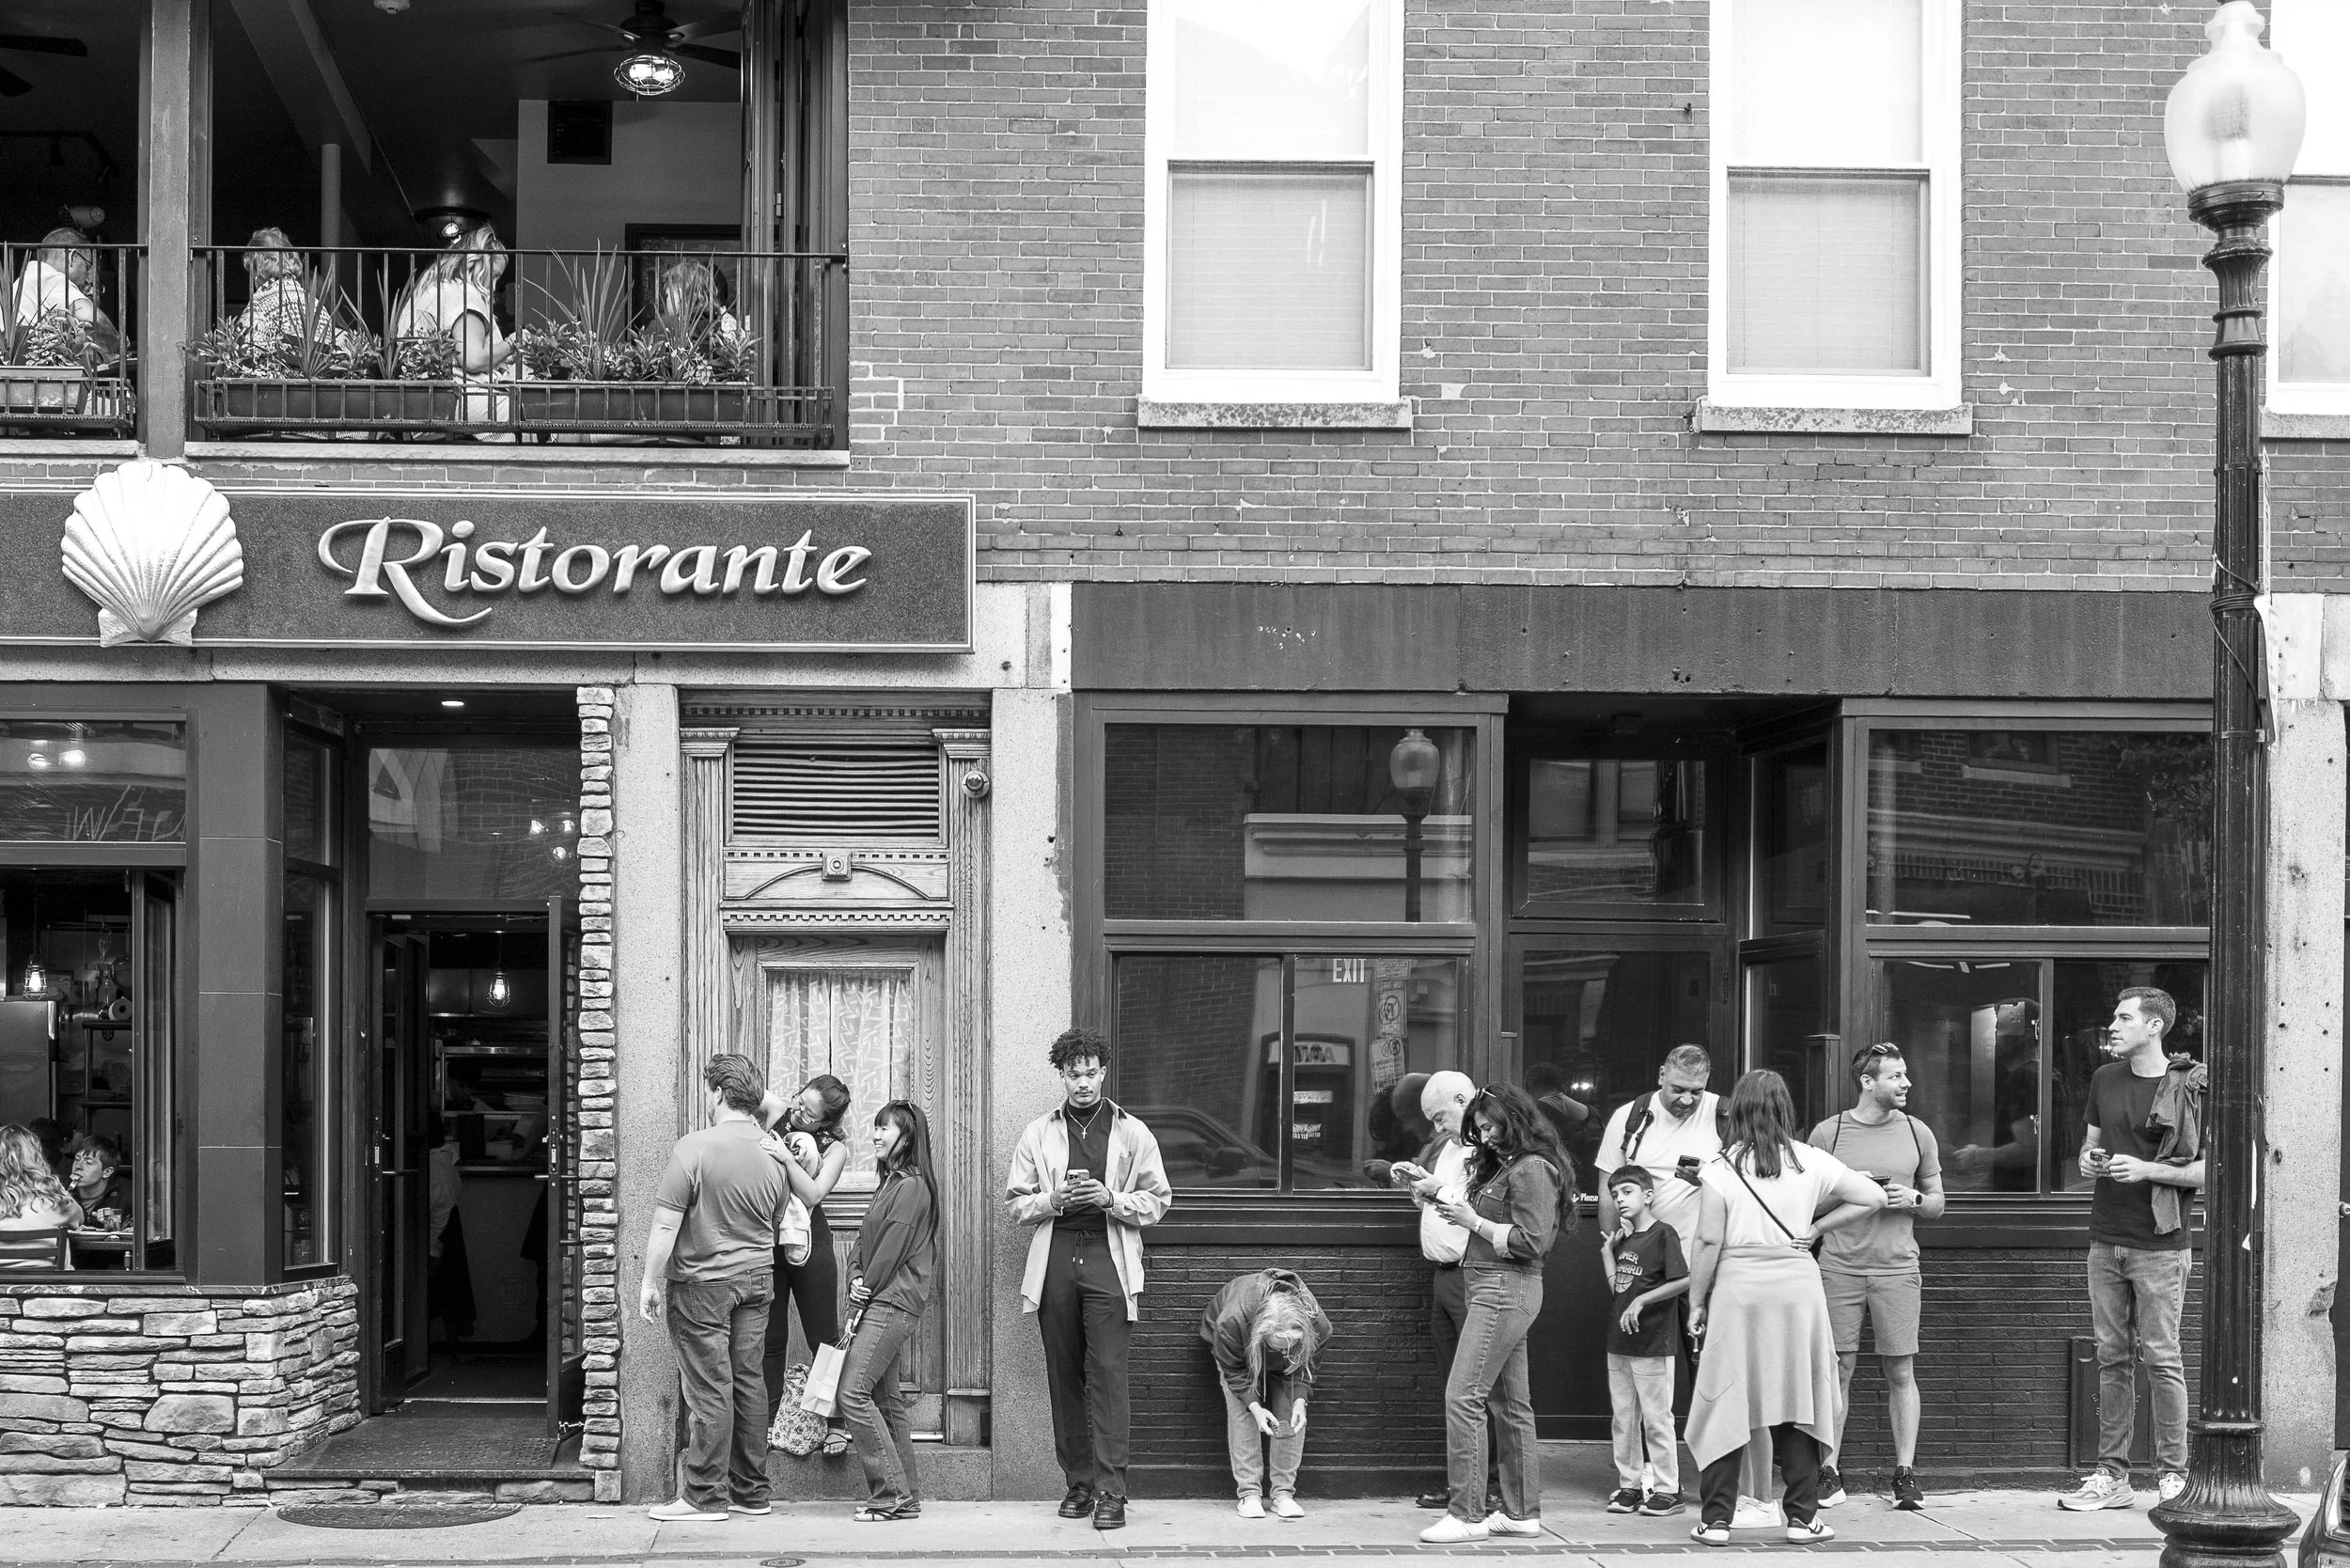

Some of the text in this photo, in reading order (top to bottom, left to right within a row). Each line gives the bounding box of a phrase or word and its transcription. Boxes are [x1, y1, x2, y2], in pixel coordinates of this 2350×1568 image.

[318, 516, 872, 625] Ristorante
[1333, 959, 1367, 982] EXIT
[1580, 1193, 1598, 1201] Please
